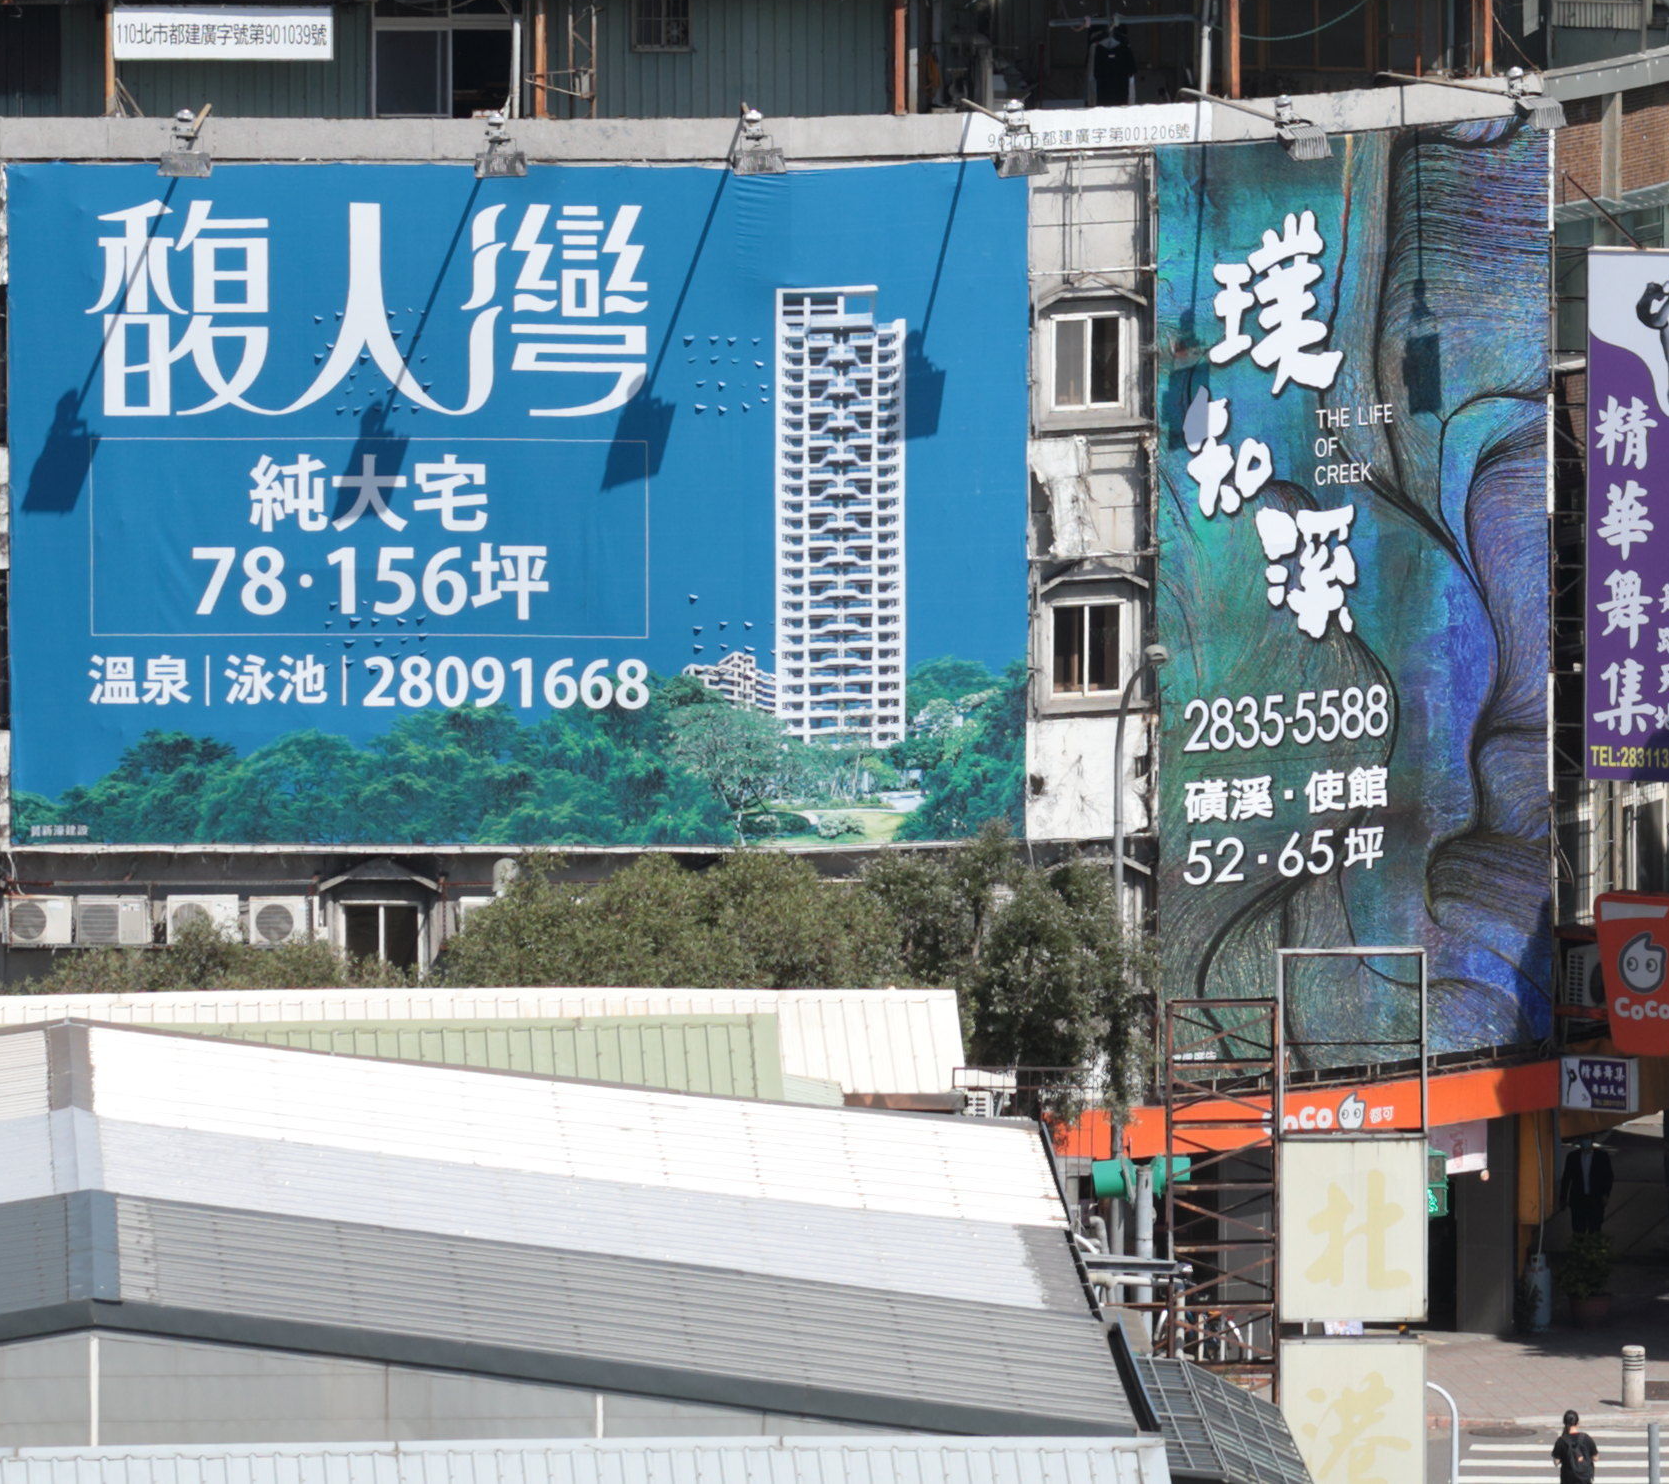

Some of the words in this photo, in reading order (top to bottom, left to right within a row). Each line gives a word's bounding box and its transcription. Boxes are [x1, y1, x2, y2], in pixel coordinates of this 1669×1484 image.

[116, 23, 328, 47] 110北市都建廣字號第901039號
[85, 200, 649, 419] 馥人灣
[1315, 408, 1352, 430] THE
[1357, 403, 1393, 427] LIFE
[1314, 438, 1339, 458] OF
[1314, 461, 1373, 485] CREEK
[248, 453, 491, 533] 純大宅
[190, 542, 550, 621] 78·156坪
[1593, 393, 1656, 737] 精華舞集
[88, 653, 192, 707] 溫泉
[224, 653, 328, 707] 泳池
[361, 655, 649, 711] 28091668
[1183, 683, 1389, 755] 2835-5588
[1183, 763, 1389, 824] 磺溪·使館
[1183, 834, 1385, 887] 52·65坪
[1370, 1106, 1395, 1124] 都可
